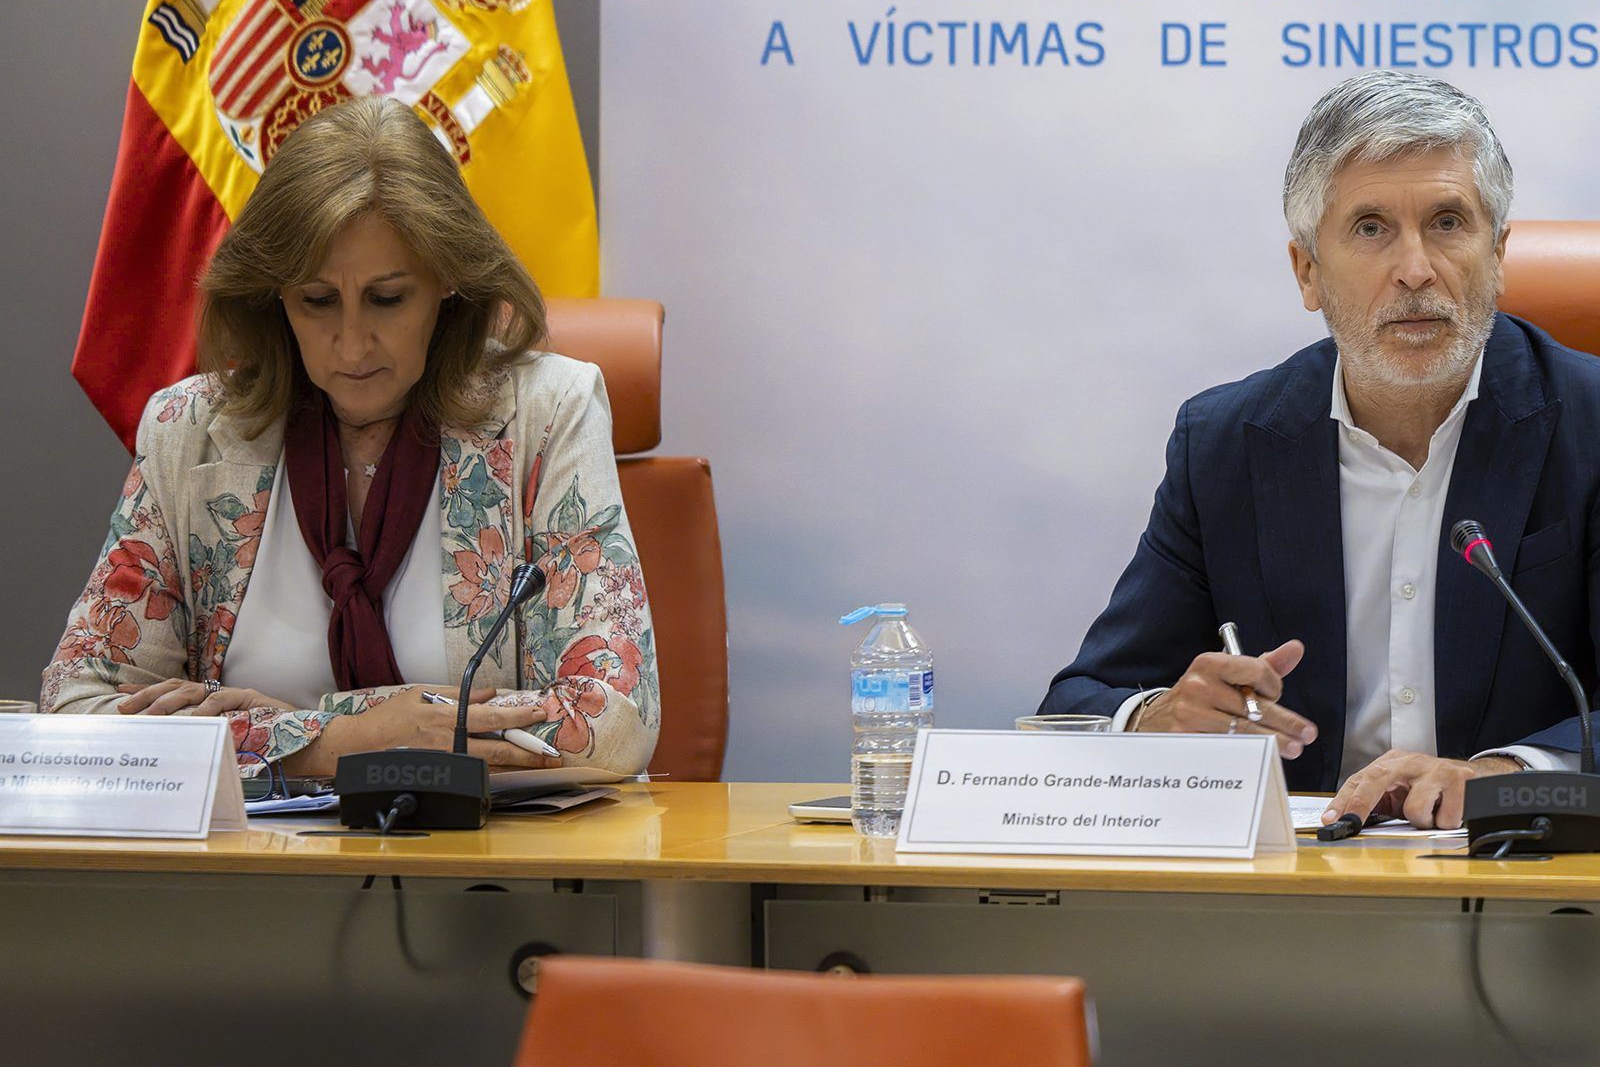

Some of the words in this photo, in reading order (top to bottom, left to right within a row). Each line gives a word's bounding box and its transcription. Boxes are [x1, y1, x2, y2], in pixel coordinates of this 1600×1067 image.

[760, 20, 795, 66] A
[847, 6, 1106, 67] VÍCTIMAS
[1160, 22, 1228, 67] DE
[1281, 22, 1600, 68] SINIESTROS
[20, 751, 114, 767] Crisóstomo
[118, 753, 159, 768] Sanz
[96, 776, 120, 791] del
[124, 778, 184, 792] Interior
[367, 763, 451, 786] BOSCH
[937, 770, 956, 786] D.
[962, 772, 1039, 788] Fernando
[1043, 773, 1181, 789] Grande-Marlaska
[1186, 774, 1244, 790] Gómez
[1498, 785, 1587, 808] BOSCH
[1002, 811, 1069, 827] Ministro
[1073, 813, 1097, 828] del
[1101, 813, 1162, 829] Interior
